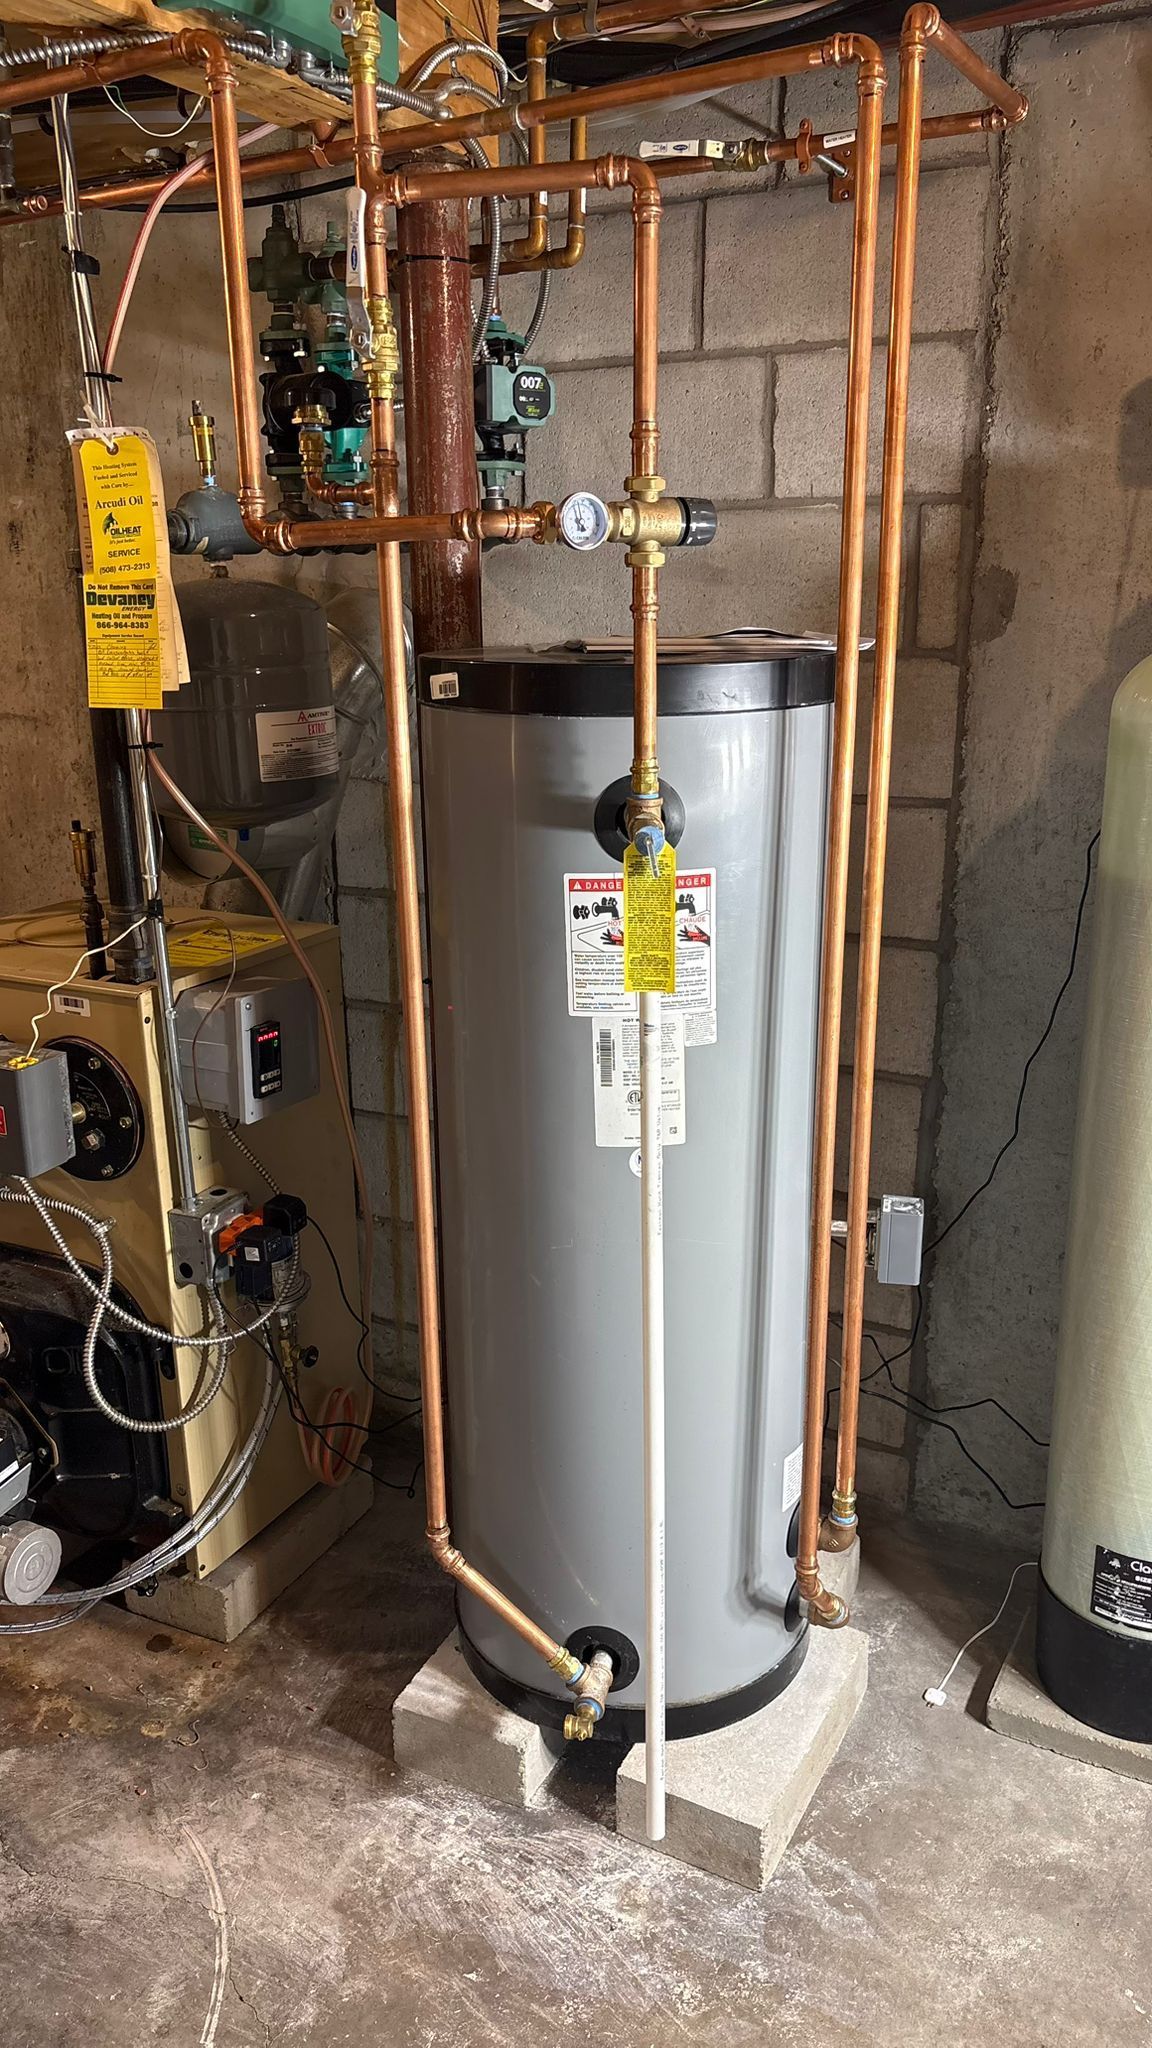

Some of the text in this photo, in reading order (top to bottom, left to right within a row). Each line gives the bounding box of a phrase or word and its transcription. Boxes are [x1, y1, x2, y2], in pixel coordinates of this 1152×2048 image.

[95, 497, 126, 510] Arcudi
[129, 496, 143, 505] Oil
[110, 526, 142, 536] OILHEAT
[108, 548, 140, 558] SERVICE
[100, 562, 150, 575] (508) 473-2313
[86, 592, 155, 609] Devaney
[585, 882, 622, 890] DANGE
[678, 877, 706, 886] NGER
[1130, 1560, 1152, 1574] Cla
